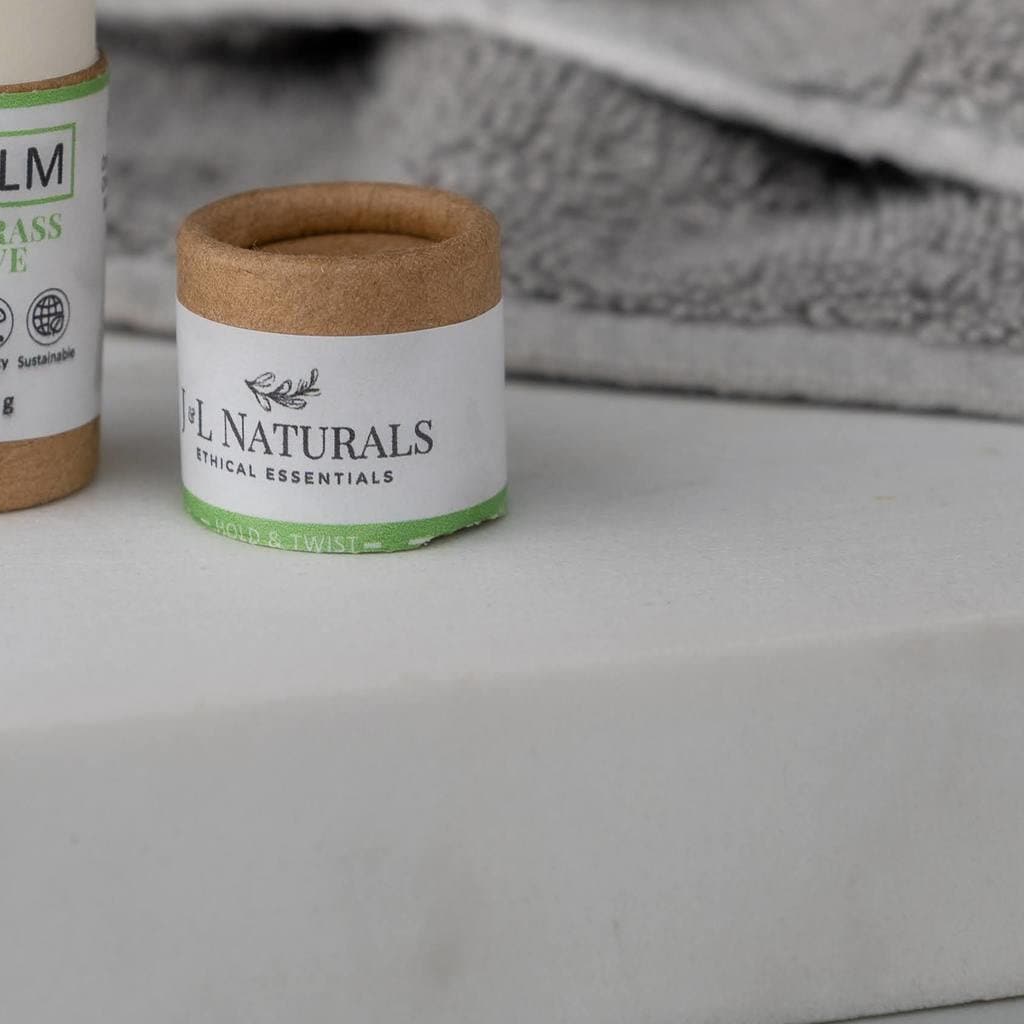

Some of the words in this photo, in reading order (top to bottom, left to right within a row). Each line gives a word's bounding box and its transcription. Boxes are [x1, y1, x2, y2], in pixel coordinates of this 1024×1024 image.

[17, 347, 76, 369] Sustainable
[2, 396, 14, 414] g
[221, 407, 434, 461] NATURALS
[196, 447, 256, 478] ETHICAL
[266, 468, 394, 485] ESSENTIALS
[291, 532, 359, 553] TWIST
